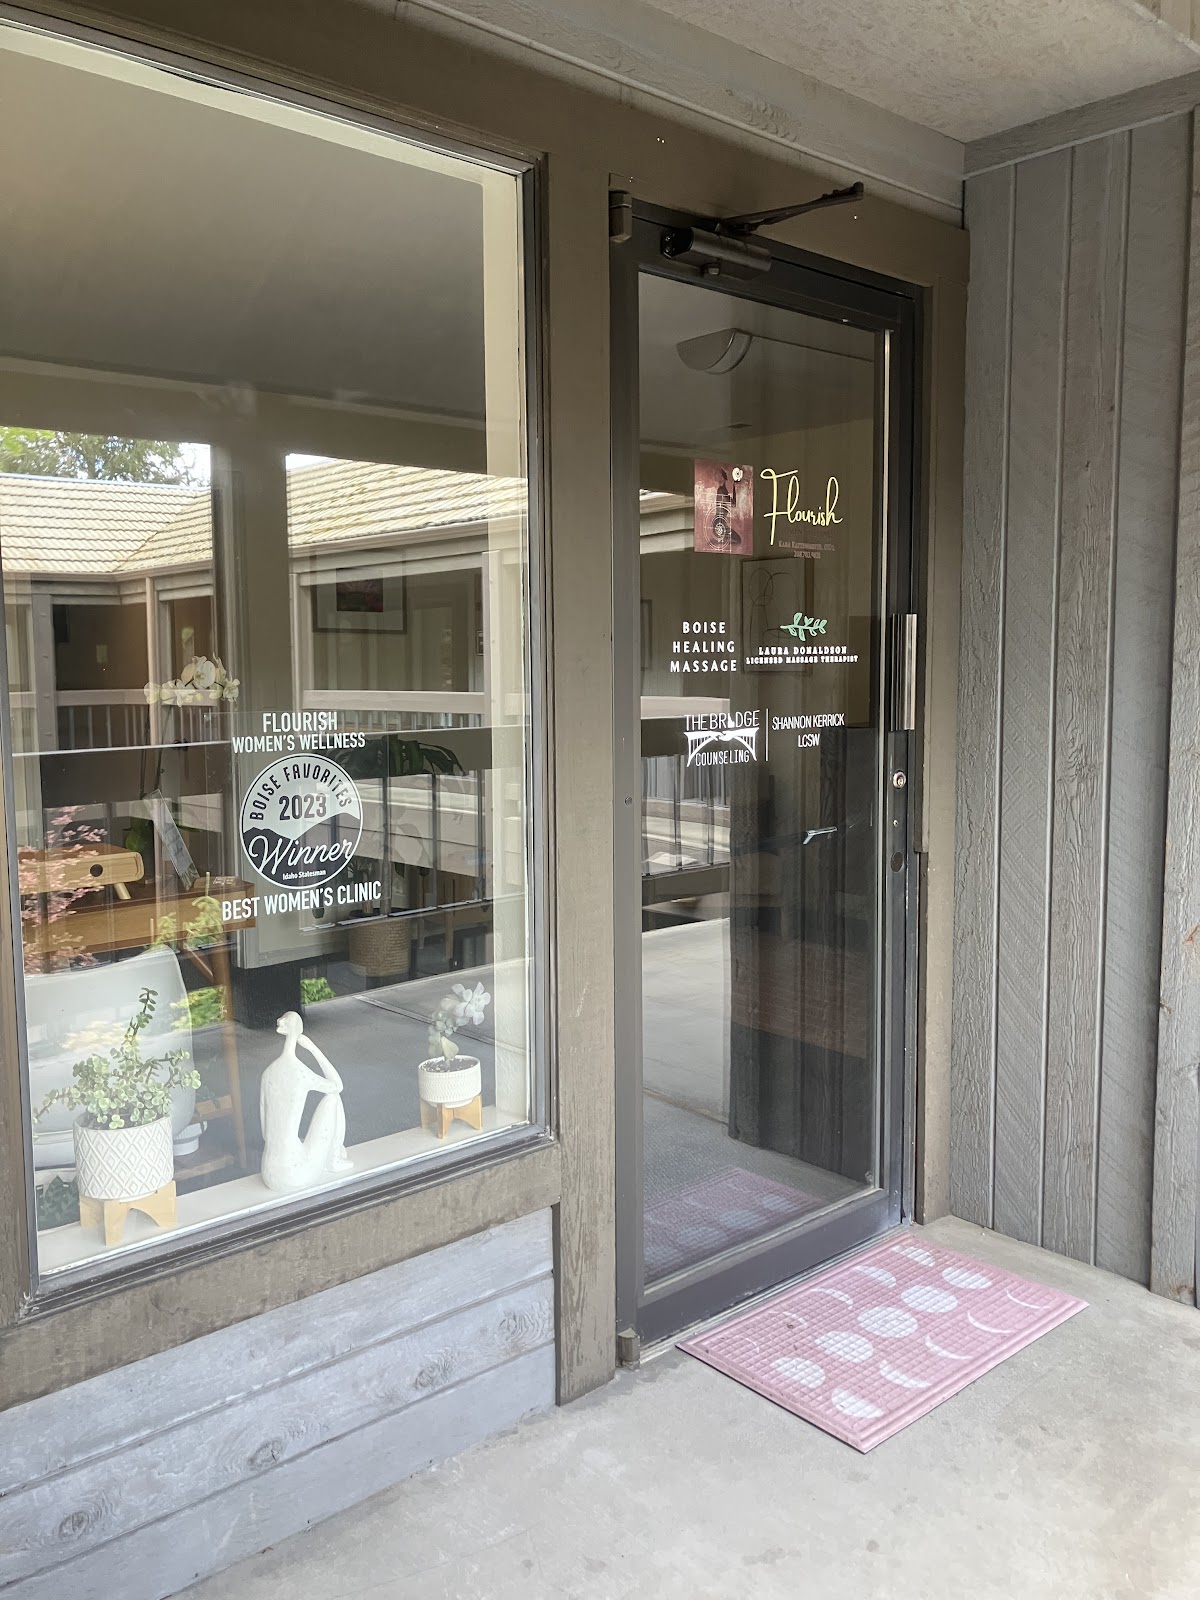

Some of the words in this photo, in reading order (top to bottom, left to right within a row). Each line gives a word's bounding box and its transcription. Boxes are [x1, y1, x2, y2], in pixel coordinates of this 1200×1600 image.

[760, 468, 843, 546] Flourish
[682, 621, 726, 634] BOISE
[672, 641, 735, 654] HEALING
[758, 646, 789, 655] LAURA
[793, 646, 847, 655] DONALDSON
[670, 660, 737, 673] MASSAGE
[745, 656, 783, 665] LICENSED
[785, 656, 818, 664] MASSAGE
[820, 655, 859, 664] THERAPIST
[262, 711, 338, 733] FLOURISH
[683, 713, 708, 731] THE
[772, 715, 812, 731] SHANNON
[812, 713, 845, 728] KERRICK
[232, 734, 295, 754] WOMEN'S
[299, 732, 366, 751] WELLNESS
[797, 733, 820, 748] LCSW
[695, 749, 750, 767] COUNSELING
[249, 775, 281, 821] BOISE
[283, 763, 353, 808] FAVORITES
[278, 793, 327, 821] 2023
[249, 835, 353, 875] Winner
[282, 872, 298, 881] Idaho
[298, 869, 327, 879] Statesman
[222, 897, 260, 921] BEST
[264, 887, 333, 915] WOMEN'S
[337, 880, 382, 905] CLINIC
